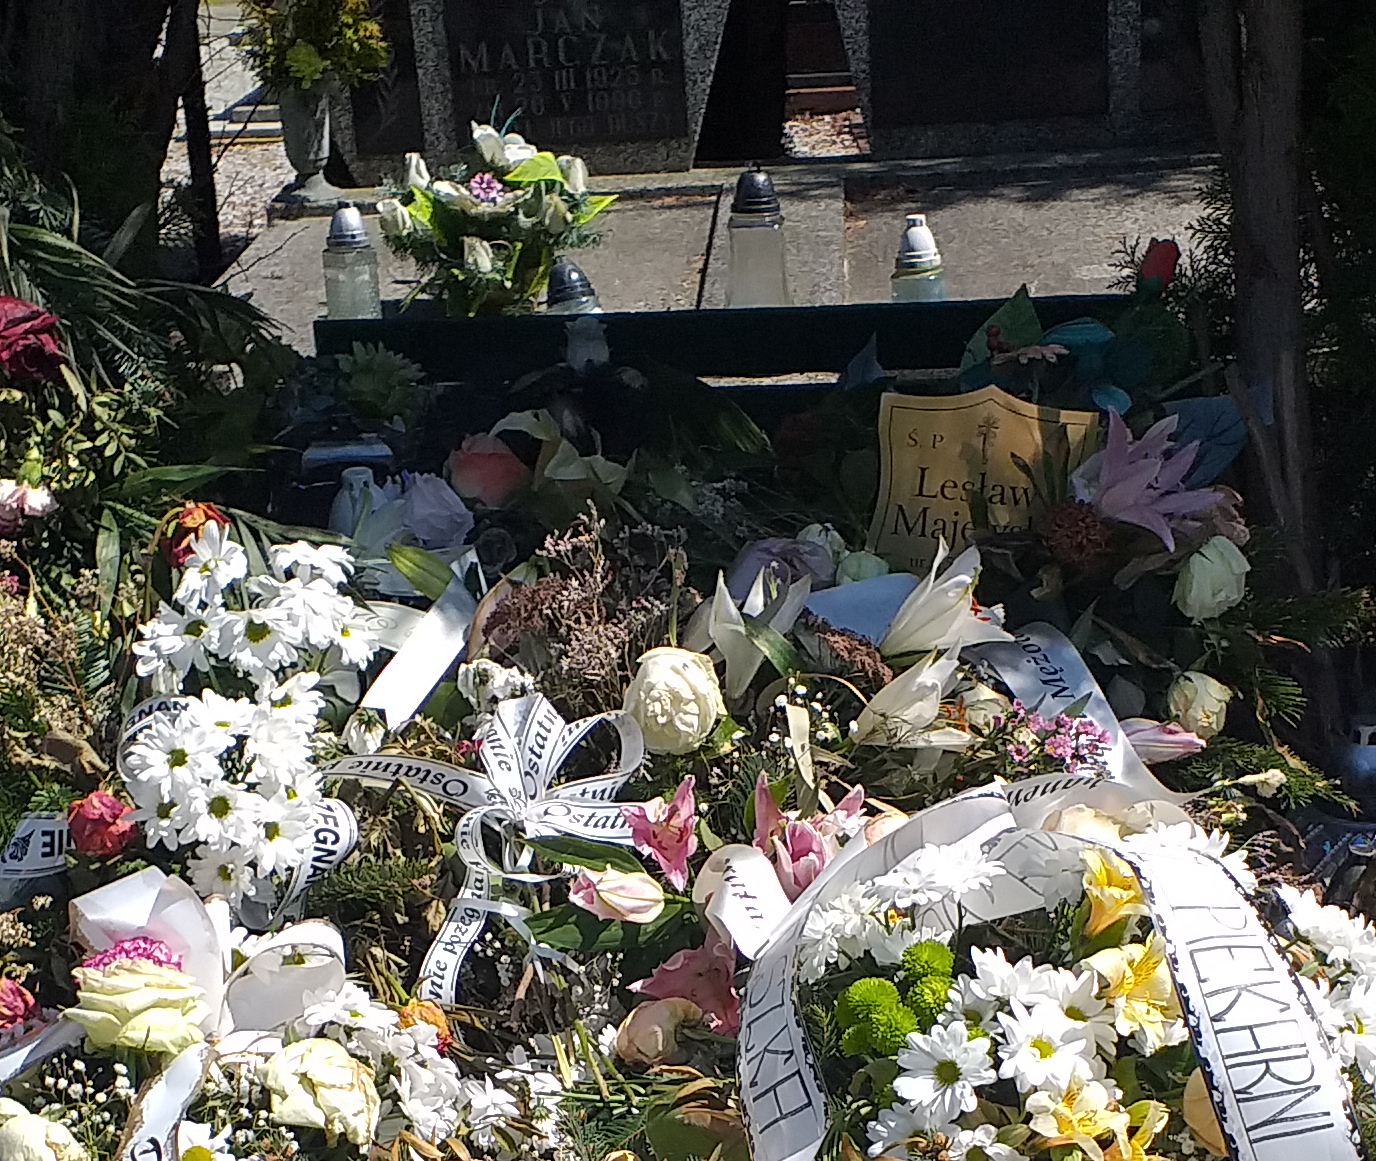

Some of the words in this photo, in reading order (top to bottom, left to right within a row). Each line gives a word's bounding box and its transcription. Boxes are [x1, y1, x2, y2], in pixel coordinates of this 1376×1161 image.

[525, 4, 603, 35] JAN
[458, 29, 673, 73] MARCZAK
[347, 758, 469, 797] Ostatnie
[1170, 905, 1336, 1144] PIEKARNI
